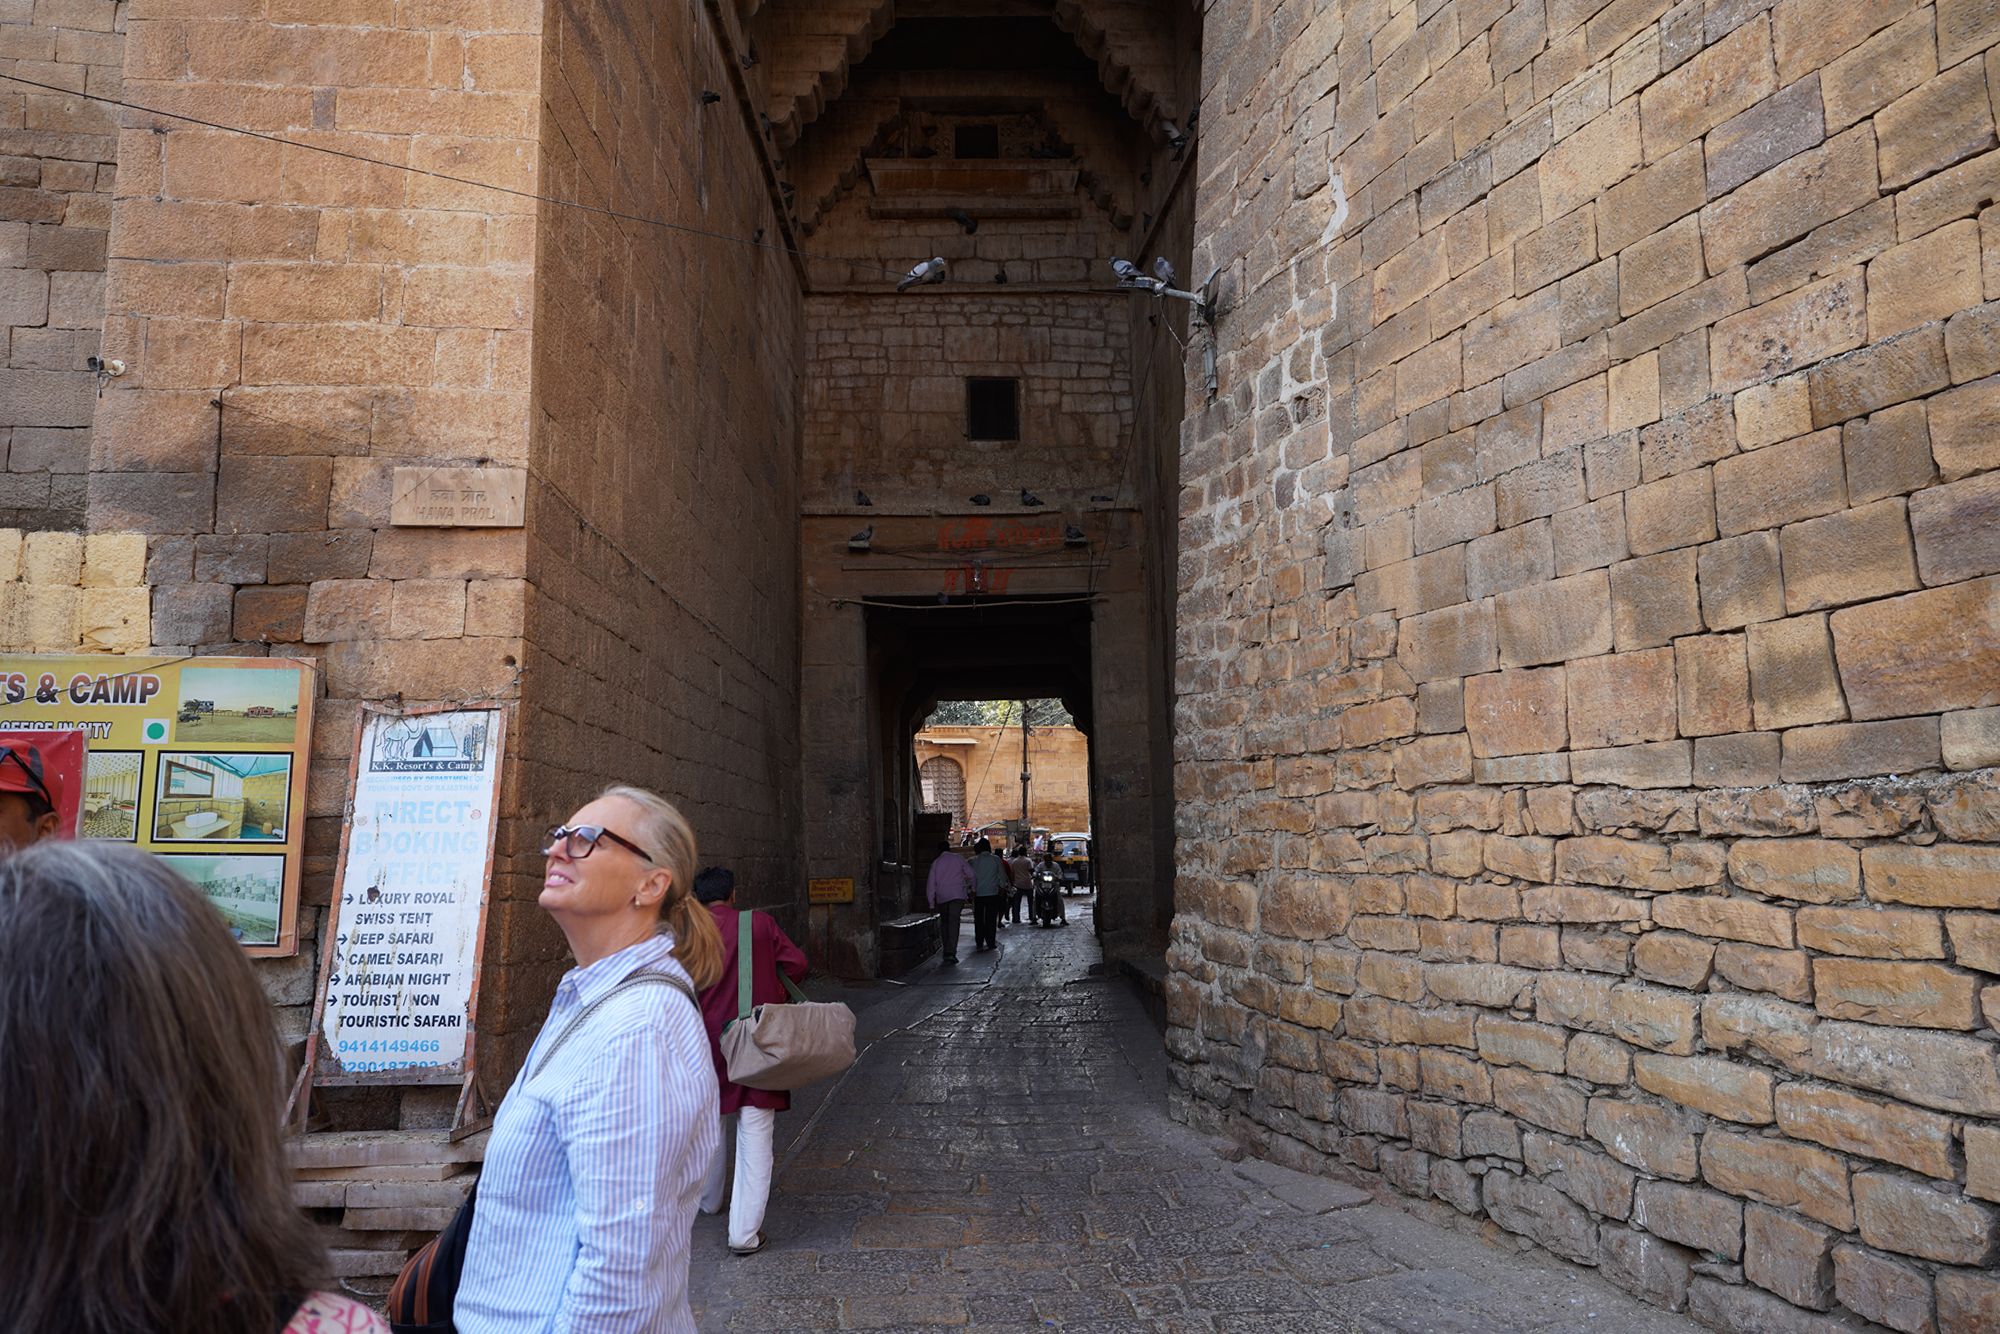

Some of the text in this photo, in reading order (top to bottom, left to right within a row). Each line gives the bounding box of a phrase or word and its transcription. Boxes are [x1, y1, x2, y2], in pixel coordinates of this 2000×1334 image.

[415, 506, 455, 520] HAWA
[35, 673, 60, 703] &
[69, 673, 160, 704] CAMP
[396, 760, 434, 770] Resort's
[435, 761, 446, 770] &
[372, 800, 471, 825] DIRECT
[355, 832, 479, 855] BOOKING
[366, 862, 462, 885] OFFICE
[414, 892, 456, 904] ROYAL
[355, 912, 433, 925] SWISS TENT
[352, 933, 434, 945] JEEP SAFARI
[349, 953, 443, 966] CAMEL SAFARI
[344, 973, 451, 986] ARABIAN NIGHT
[342, 994, 398, 1007] TOURIST
[411, 994, 440, 1007] NON
[338, 1015, 461, 1028] TOURISTIC SAFARI
[338, 1039, 440, 1053] 9414149466
